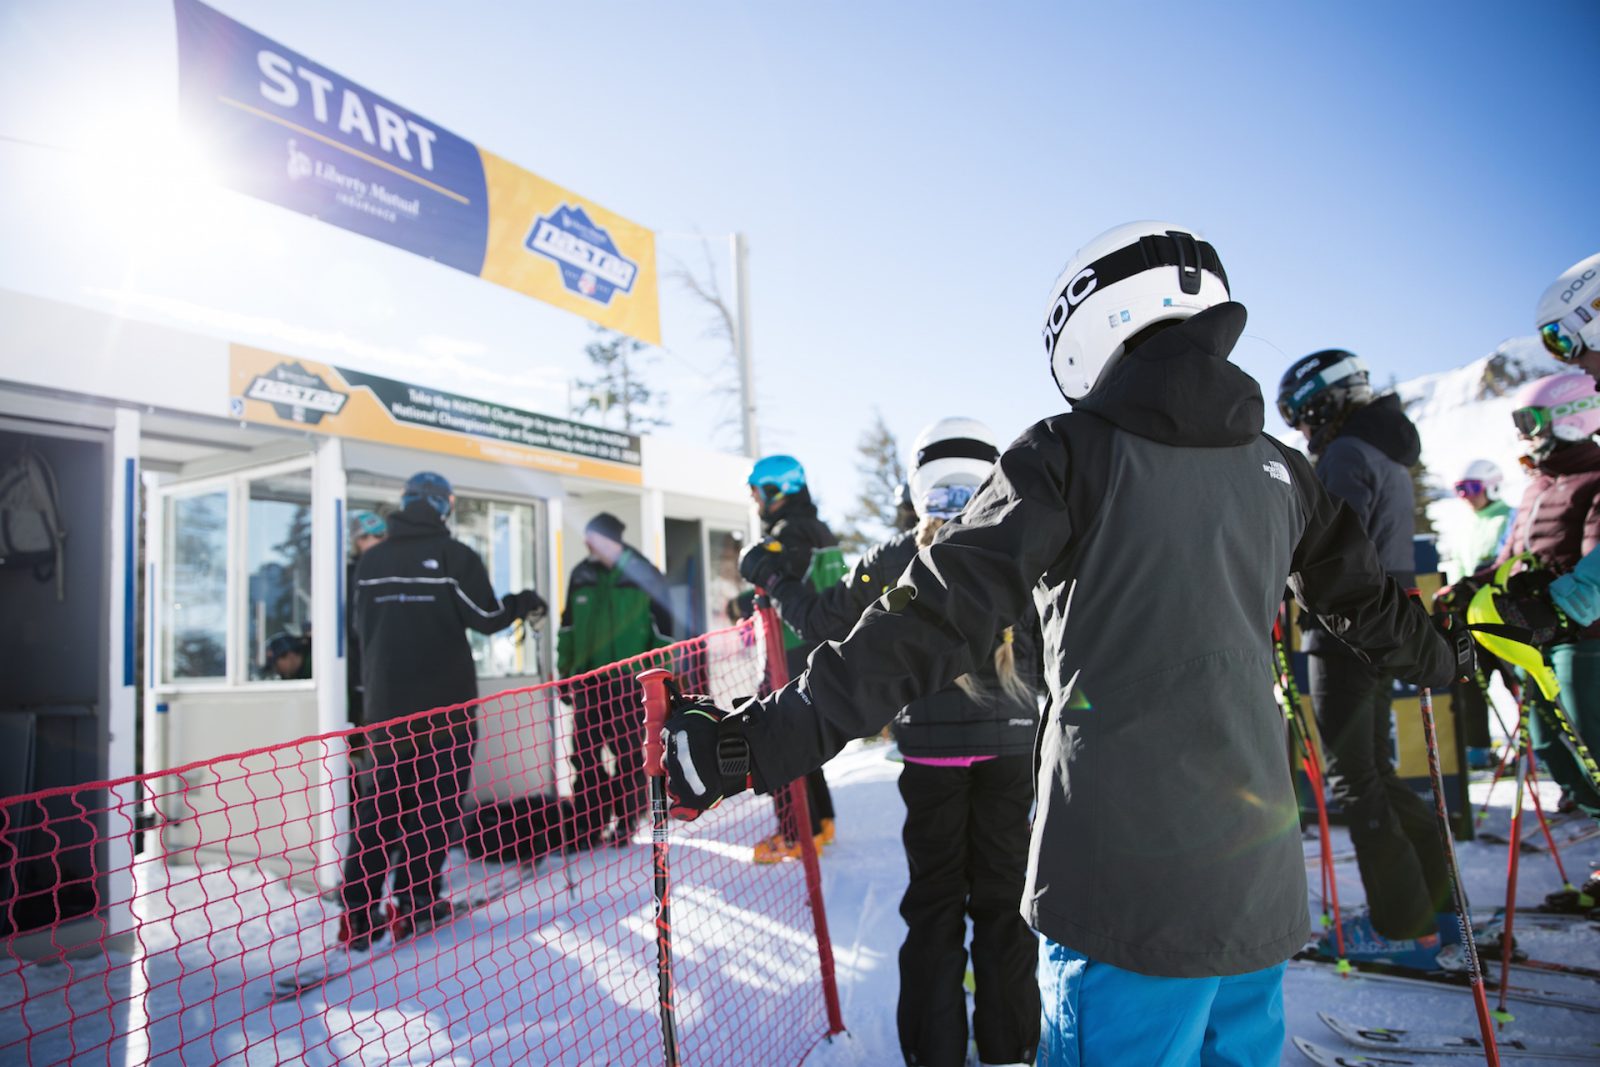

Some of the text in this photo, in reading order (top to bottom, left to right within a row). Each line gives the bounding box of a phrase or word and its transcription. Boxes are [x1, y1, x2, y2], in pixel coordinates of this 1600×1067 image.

[257, 49, 437, 171] START
[315, 160, 420, 215] Liberty Mutual
